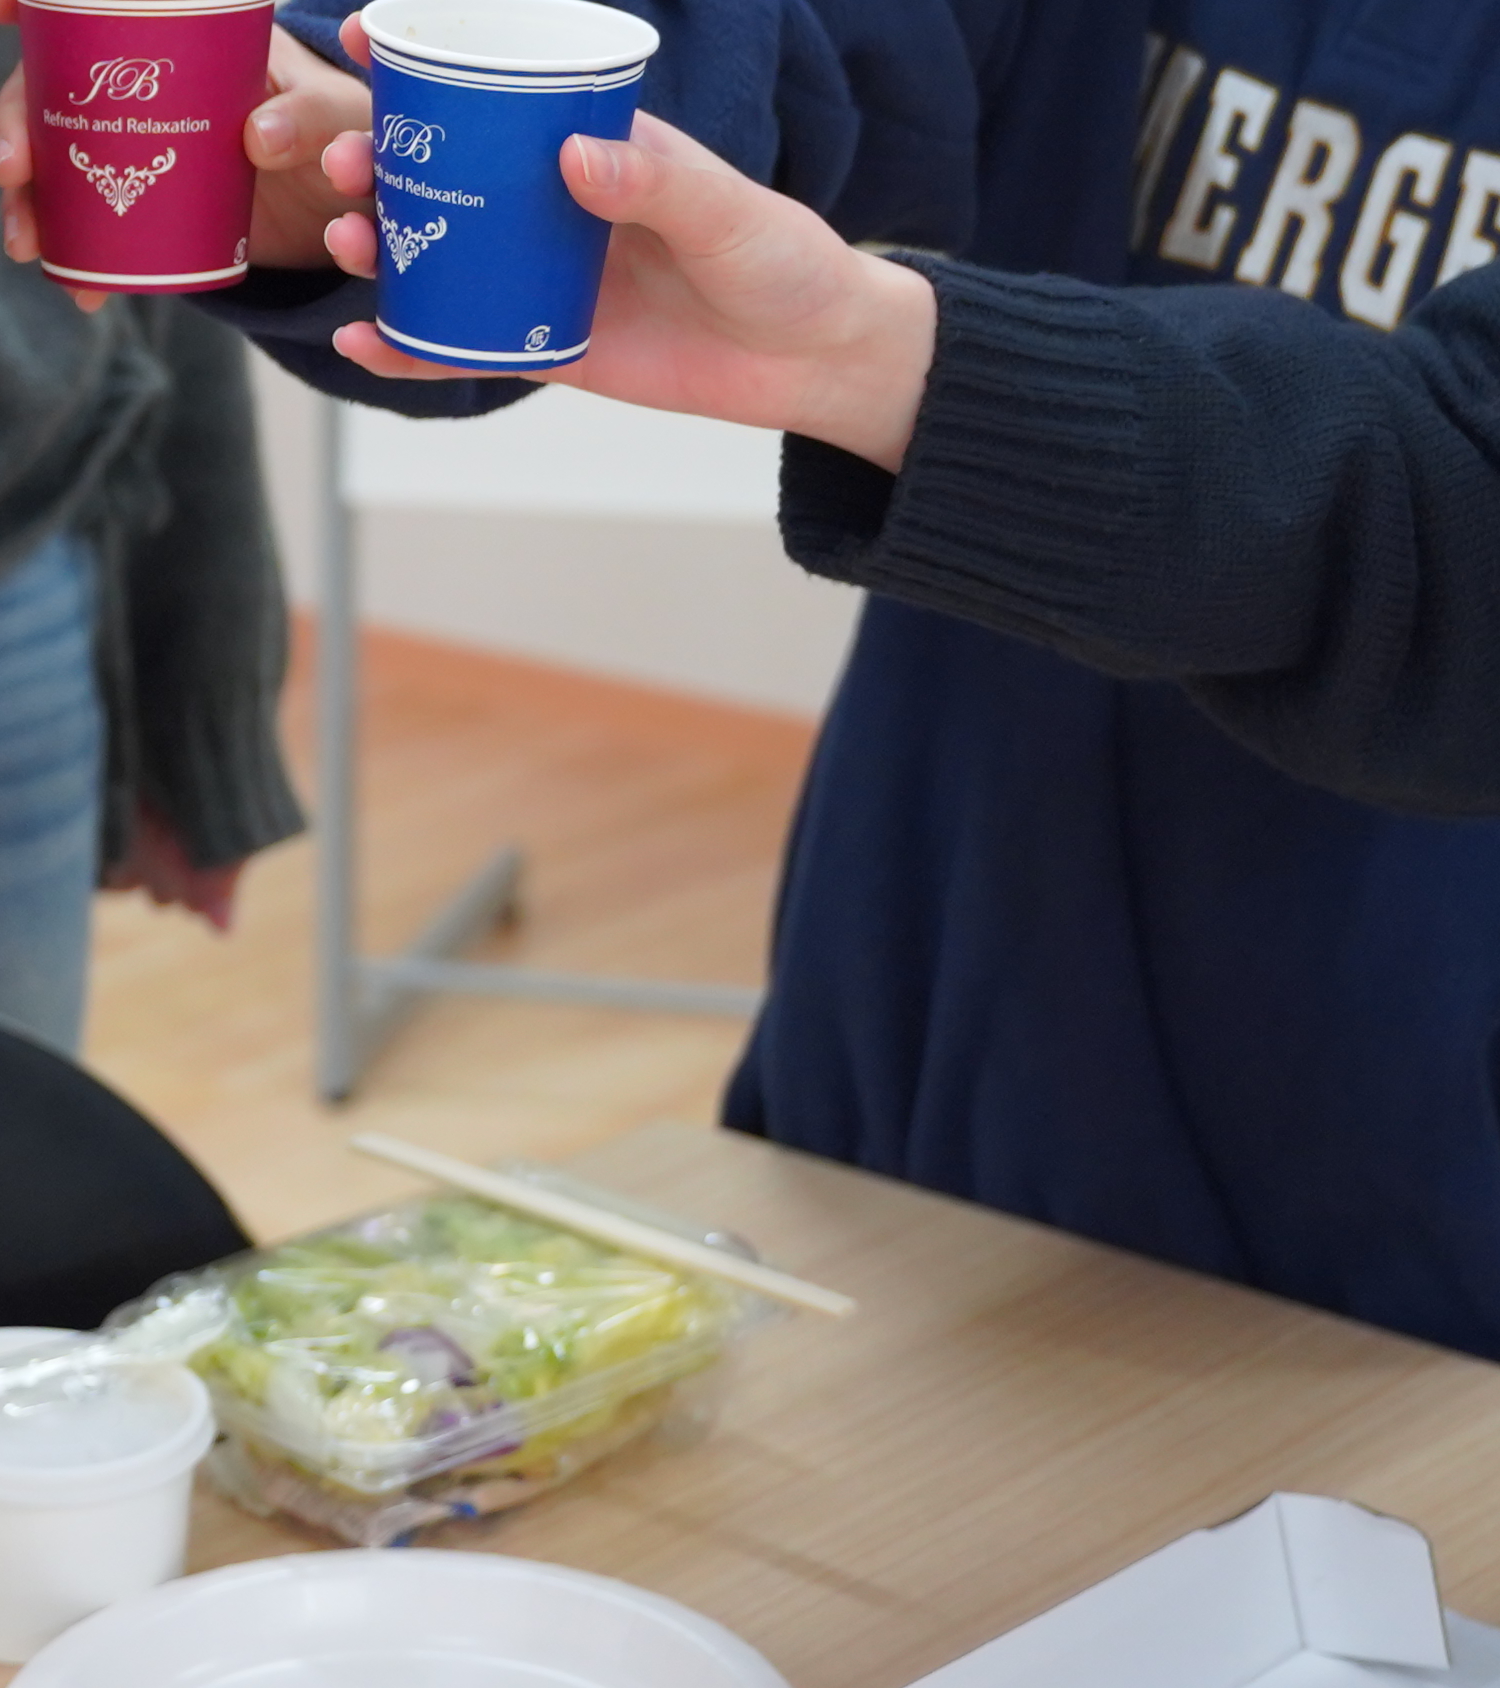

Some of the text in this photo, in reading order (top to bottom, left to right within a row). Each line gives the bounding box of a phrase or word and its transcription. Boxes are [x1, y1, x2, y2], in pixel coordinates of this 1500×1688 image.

[68, 56, 175, 106] JB
[42, 108, 211, 135] Refresh and Relaxation
[374, 113, 446, 164] JB
[383, 171, 404, 191] and
[405, 177, 486, 209] Relaxation
